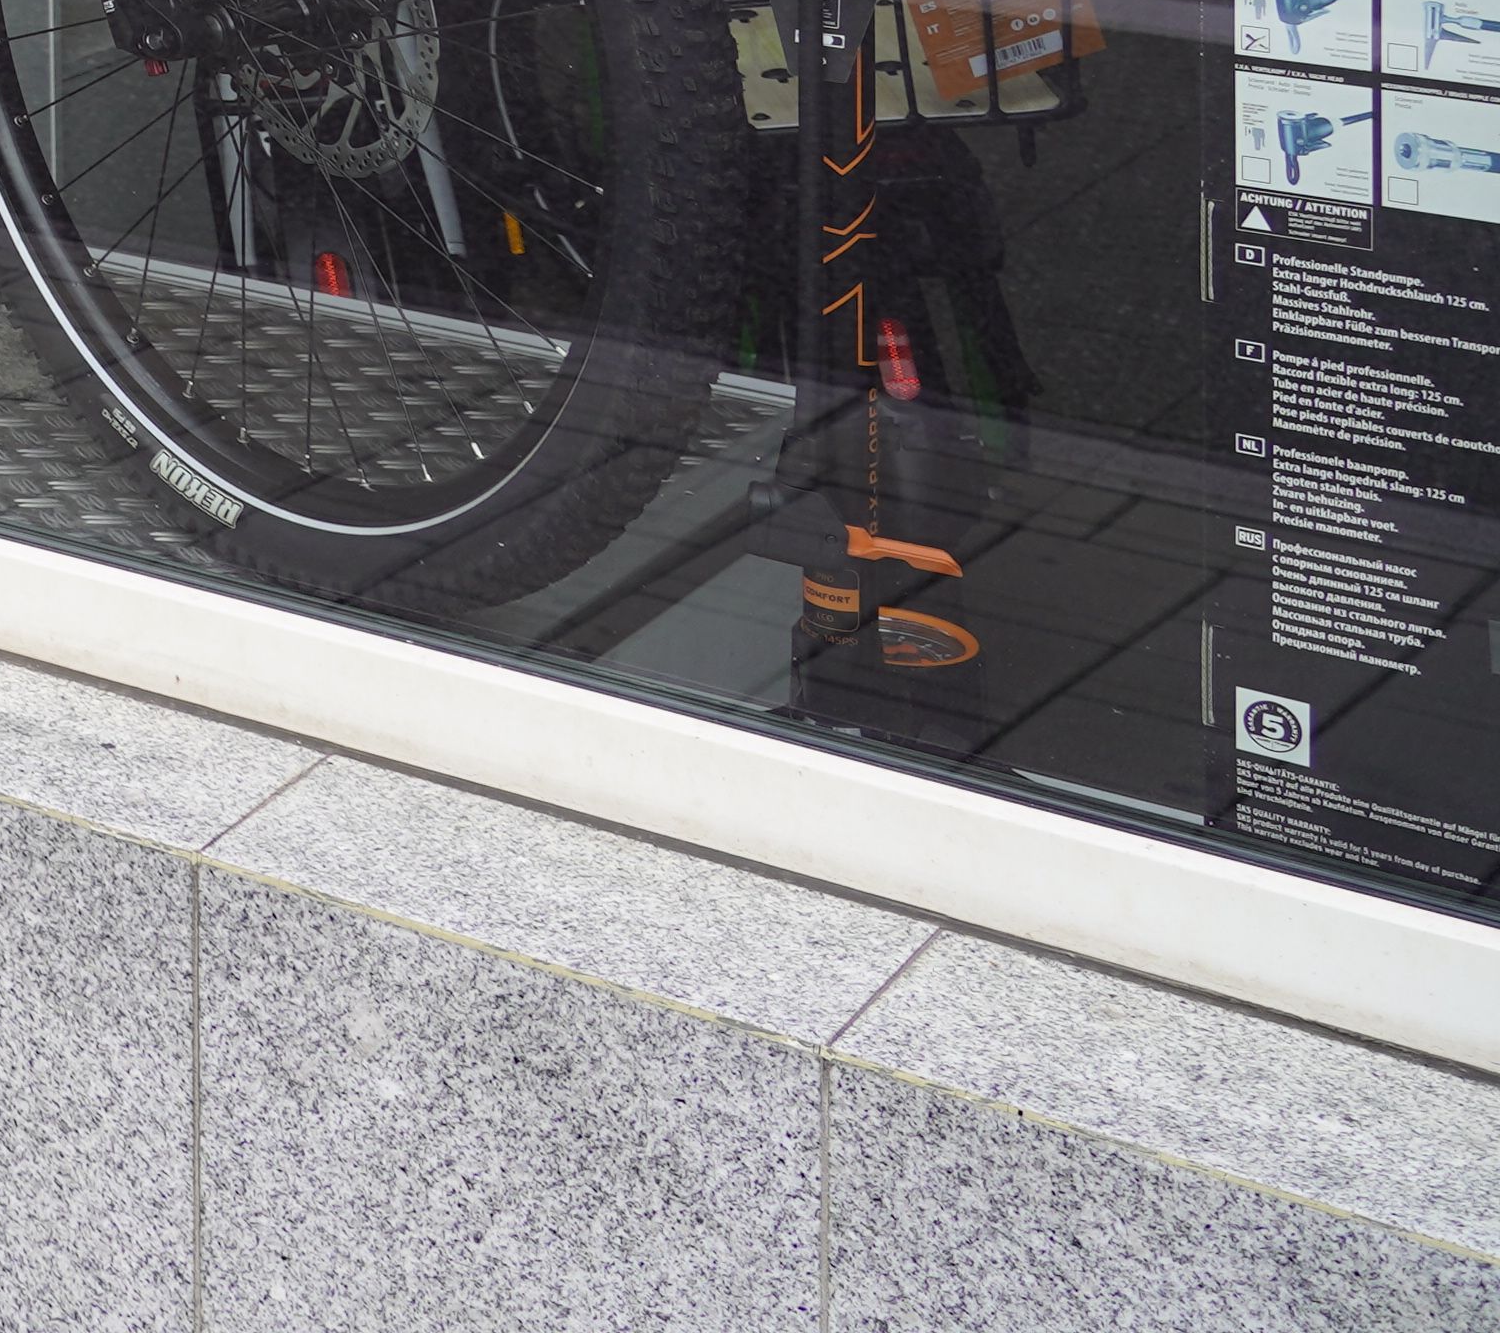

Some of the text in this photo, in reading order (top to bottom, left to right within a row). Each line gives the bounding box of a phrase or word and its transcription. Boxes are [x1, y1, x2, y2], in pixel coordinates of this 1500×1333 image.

[1240, 193, 1367, 219] ACHTUNG ATTENTION
[1246, 250, 1255, 260] D
[1272, 253, 1425, 287] Professionelle Standpumpe.
[1272, 268, 1490, 311] Extra langer Hochdruckschlauch 125 cm.
[1272, 281, 1351, 303] Stahl-Gussfuß.
[1272, 294, 1376, 320] Massives Stahlrohr.
[1272, 308, 1344, 329] Einklappbare
[1345, 320, 1373, 334] Füße
[1374, 327, 1399, 338] zum
[1400, 329, 1450, 346] besseren
[1272, 322, 1393, 351] Präzisionsmanometer.
[1246, 345, 1255, 355] F
[1243, 439, 1259, 451] NL
[1272, 445, 1410, 480] Professionele baanpomp.
[150, 449, 244, 529] REKON
[1239, 531, 1262, 545] RUS
[1272, 540, 1417, 578] Профессиональный насос
[1261, 713, 1285, 740] 5
